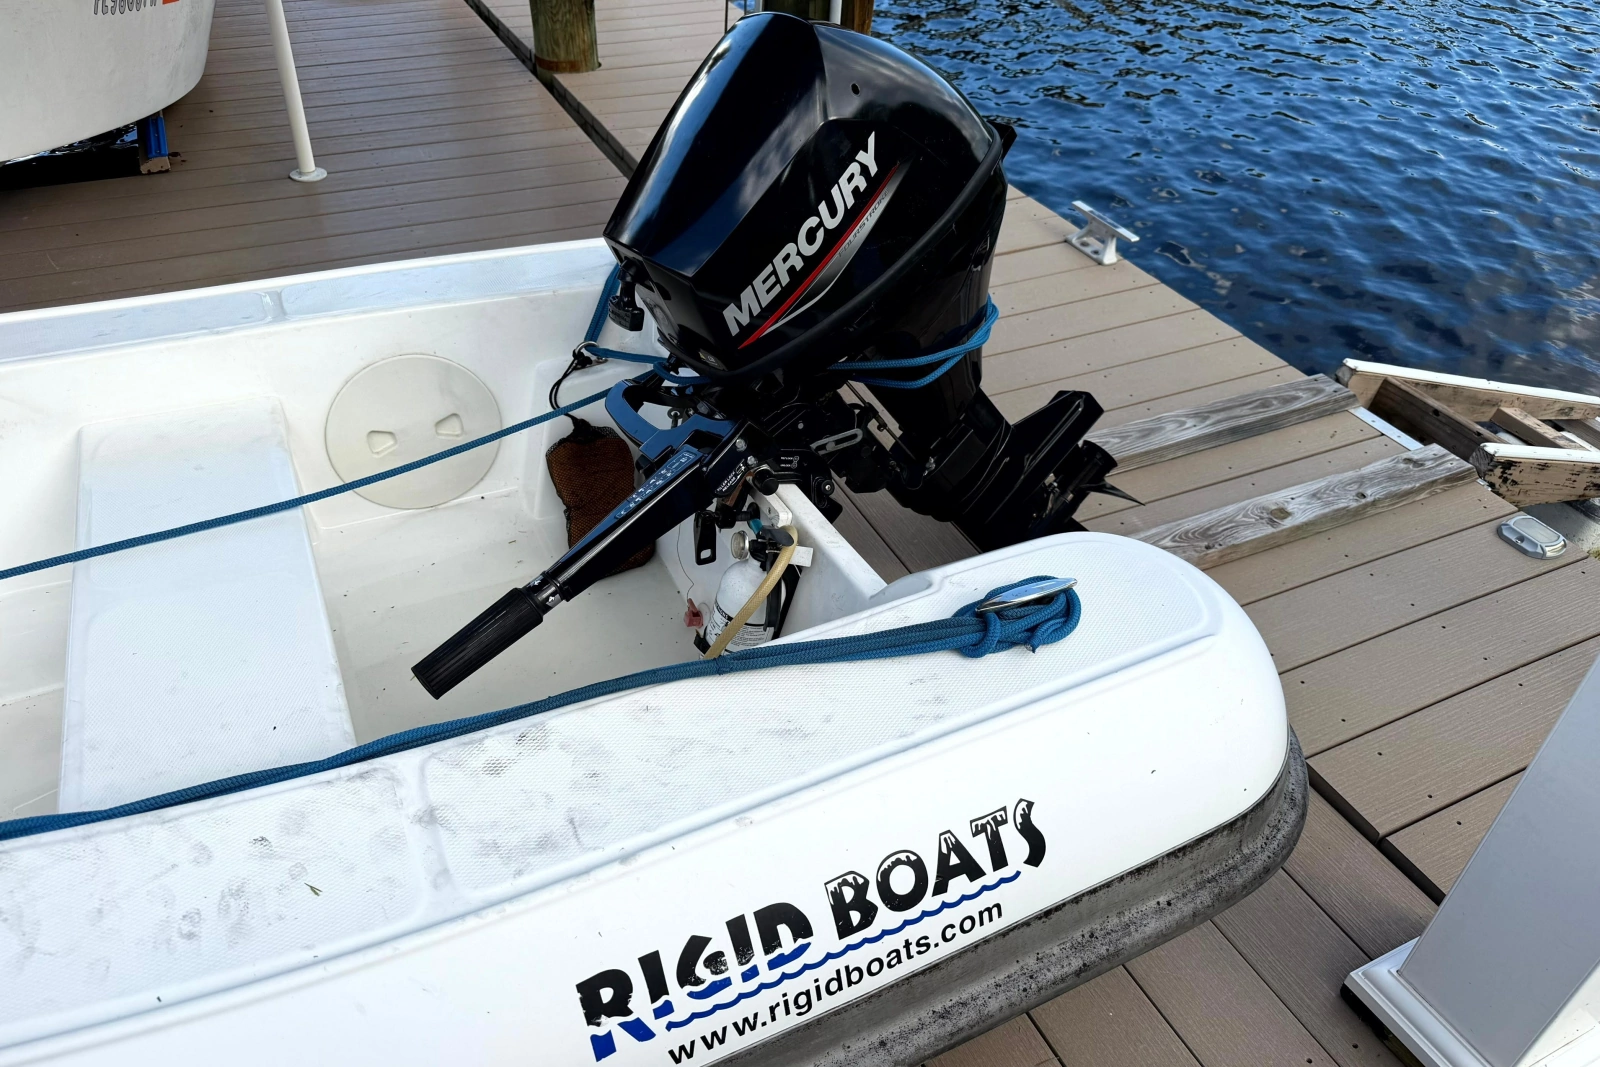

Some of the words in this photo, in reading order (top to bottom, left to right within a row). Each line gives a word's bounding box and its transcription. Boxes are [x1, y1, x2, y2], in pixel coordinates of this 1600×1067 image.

[722, 131, 878, 337] MERCURY
[575, 902, 814, 1062] RIGID
[824, 798, 1047, 941] BOATS
[667, 902, 1003, 1065] www.rigidboats.com
